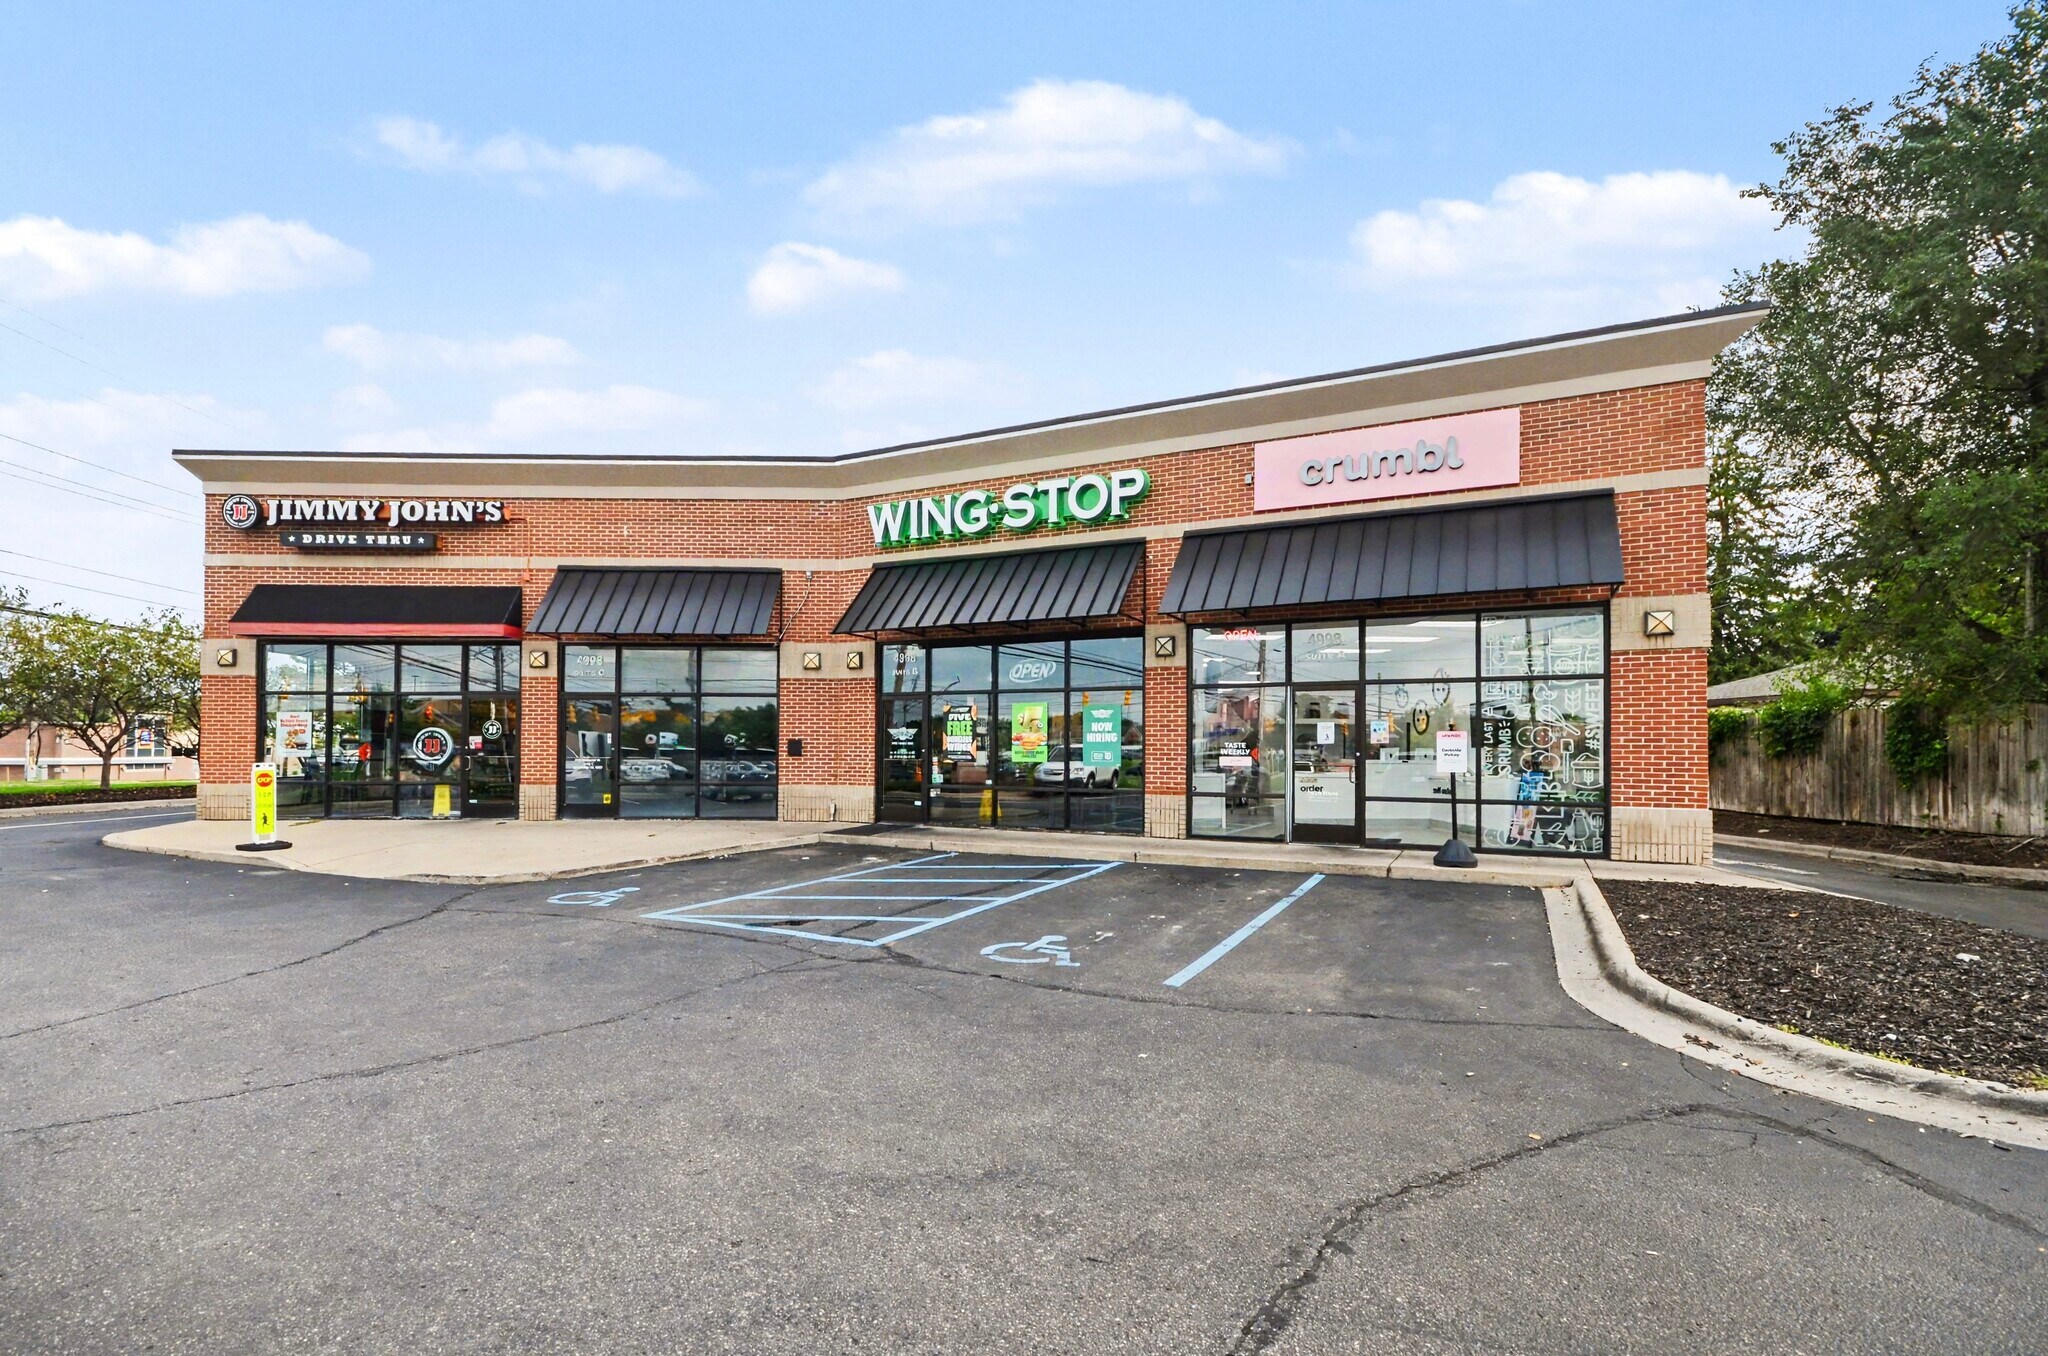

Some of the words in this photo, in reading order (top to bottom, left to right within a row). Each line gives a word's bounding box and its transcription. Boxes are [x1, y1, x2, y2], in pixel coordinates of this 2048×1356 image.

[1300, 435, 1464, 486] crumbl
[266, 499, 381, 526] JIMMY
[387, 500, 502, 527] JOHN'S
[302, 534, 358, 545] DRIVE
[365, 534, 412, 545] THRU
[1223, 629, 1257, 641] OPEN
[1012, 662, 1050, 678] OPEN
[946, 720, 972, 736] FREE
[1091, 722, 1113, 732] NOW
[1483, 721, 1493, 744] LAST
[1086, 732, 1118, 743] HIRING
